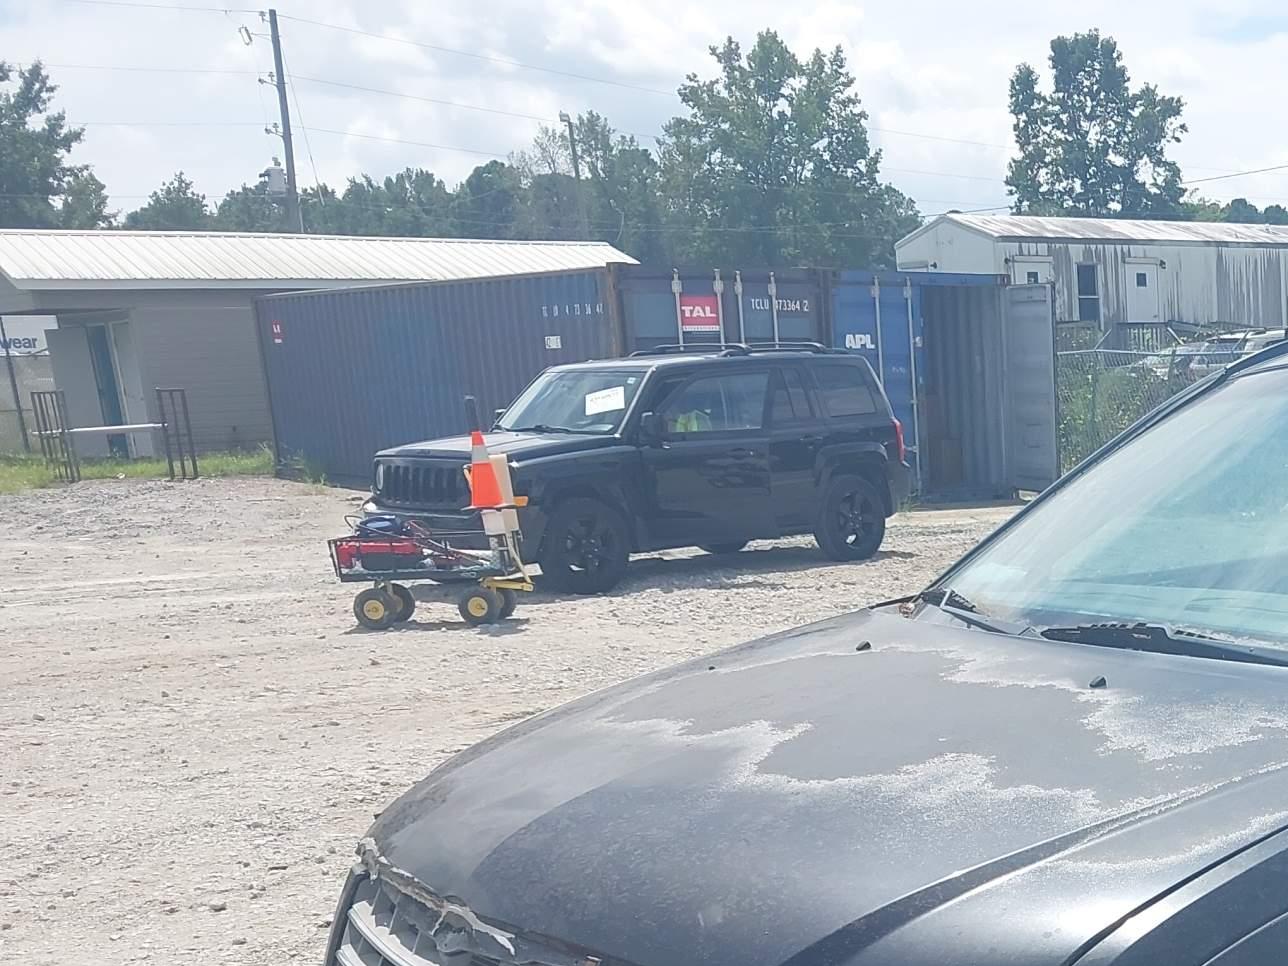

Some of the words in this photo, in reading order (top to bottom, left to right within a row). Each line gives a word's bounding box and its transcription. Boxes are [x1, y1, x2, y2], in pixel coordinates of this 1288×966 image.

[751, 299, 769, 310] TCLU
[681, 305, 717, 318] TAL
[845, 333, 875, 349] APL
